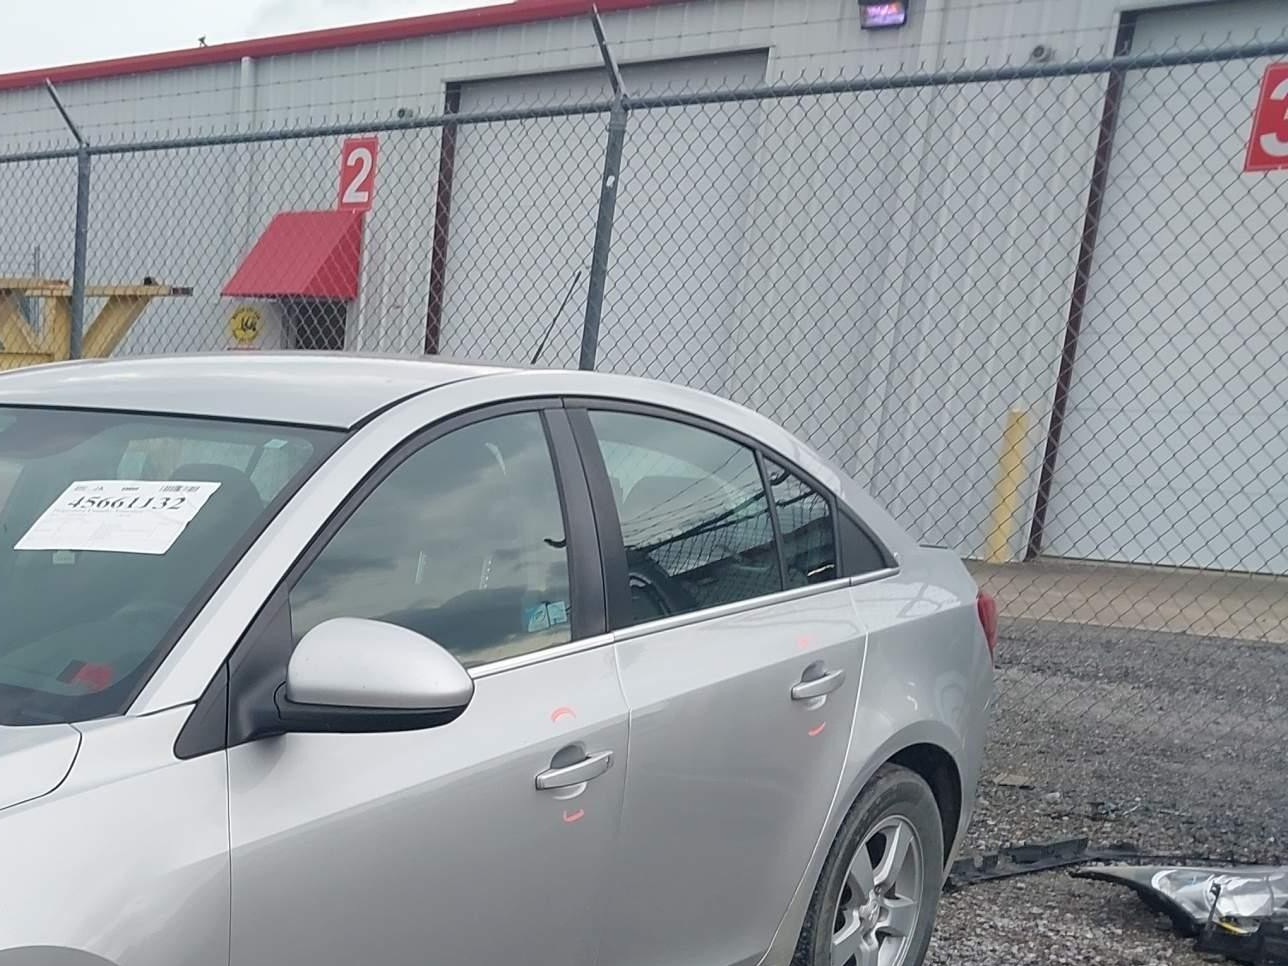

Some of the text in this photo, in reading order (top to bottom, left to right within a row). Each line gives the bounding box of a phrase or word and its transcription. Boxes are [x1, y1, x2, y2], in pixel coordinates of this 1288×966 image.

[1258, 78, 1288, 157] 3
[342, 147, 373, 203] 2
[68, 495, 186, 510] 45661132
